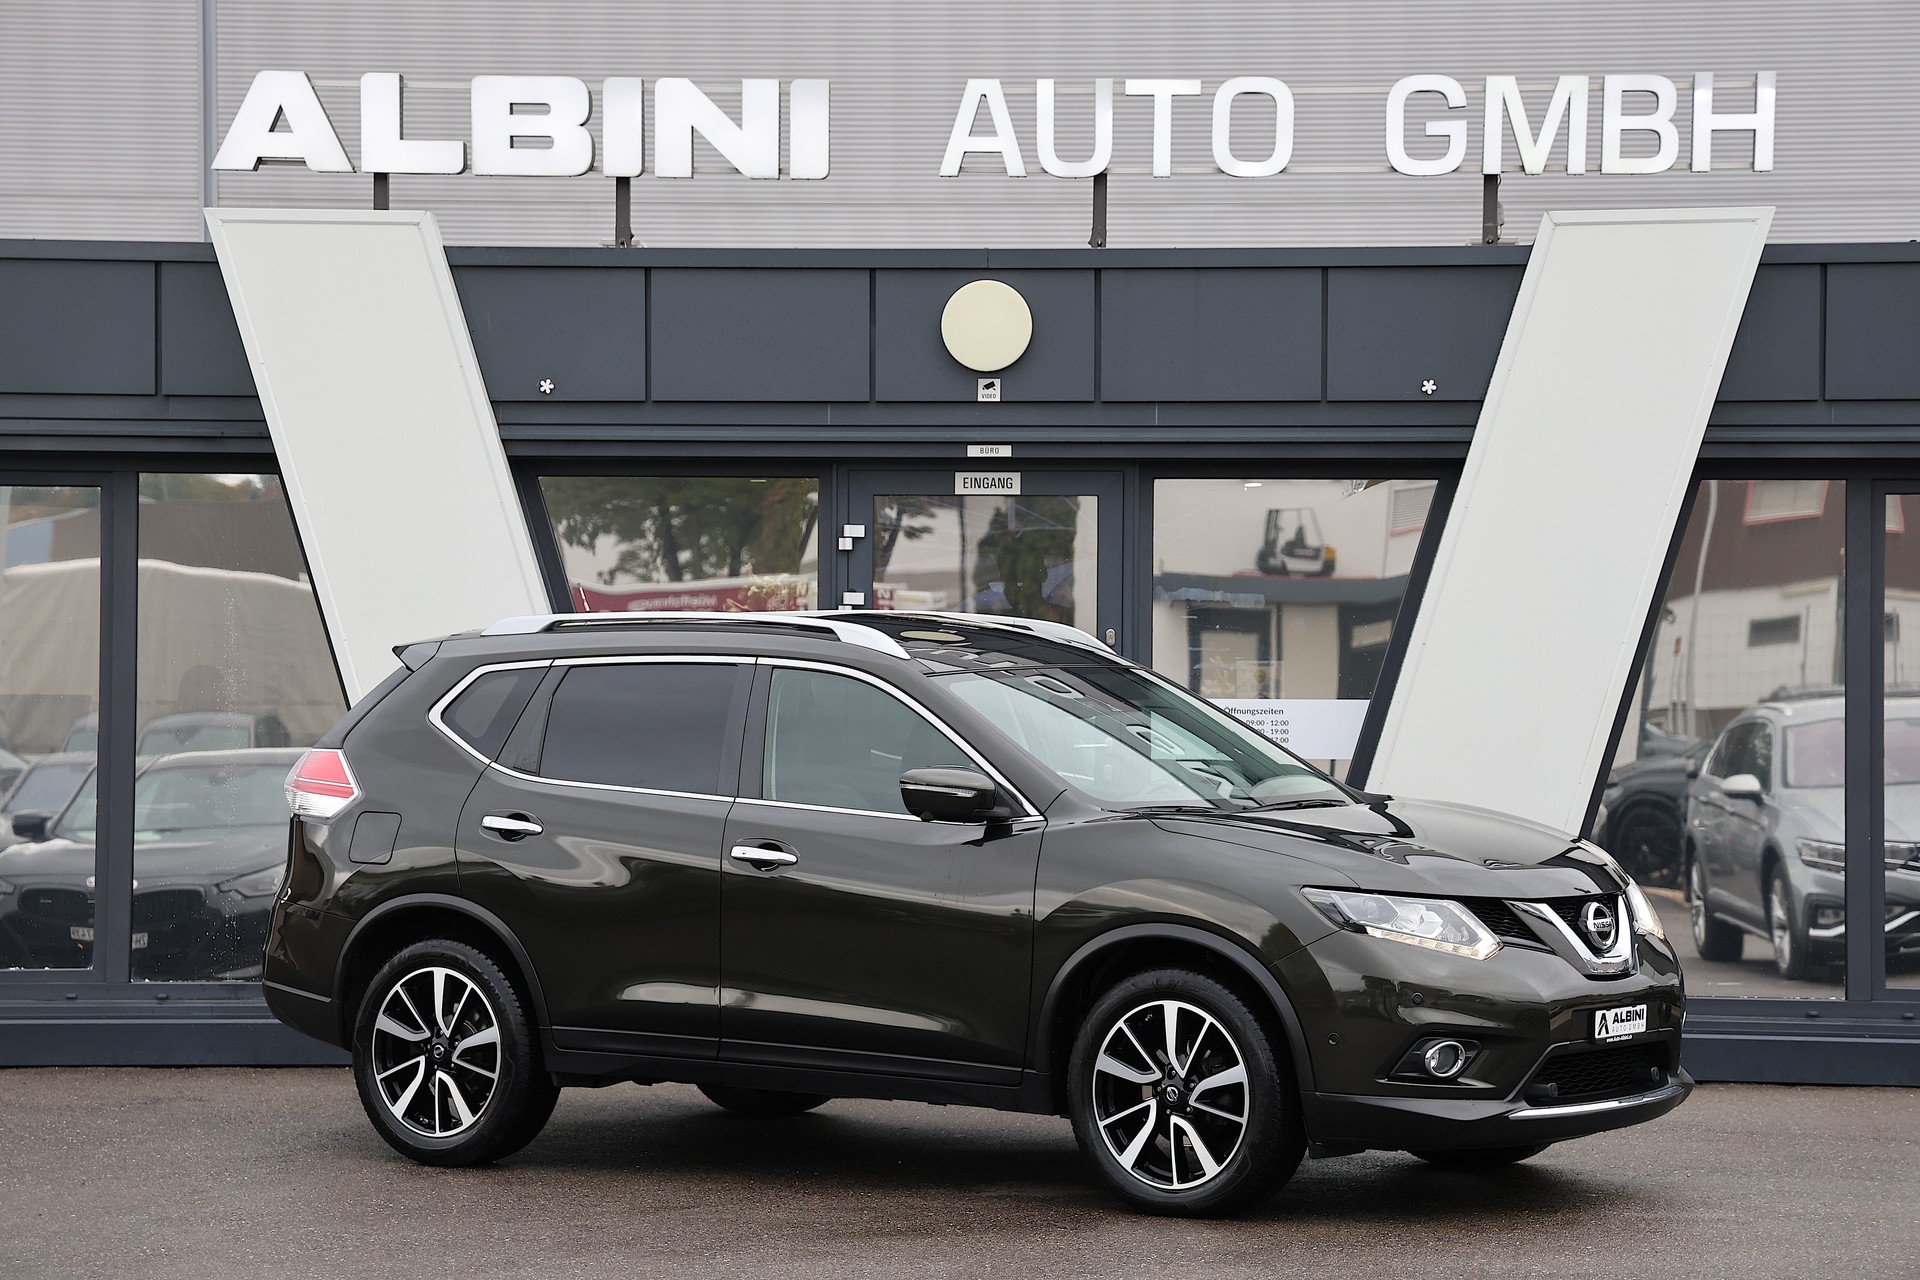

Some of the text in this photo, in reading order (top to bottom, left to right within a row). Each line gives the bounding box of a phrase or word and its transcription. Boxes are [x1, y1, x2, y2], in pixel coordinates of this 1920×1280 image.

[210, 70, 1777, 180] ALBINI AUTO GMBH
[979, 446, 1000, 454] BÜRO
[963, 477, 1013, 489] EINGANG
[1270, 719, 1289, 727] 12:00
[1612, 1008, 1645, 1024] ALBINI
